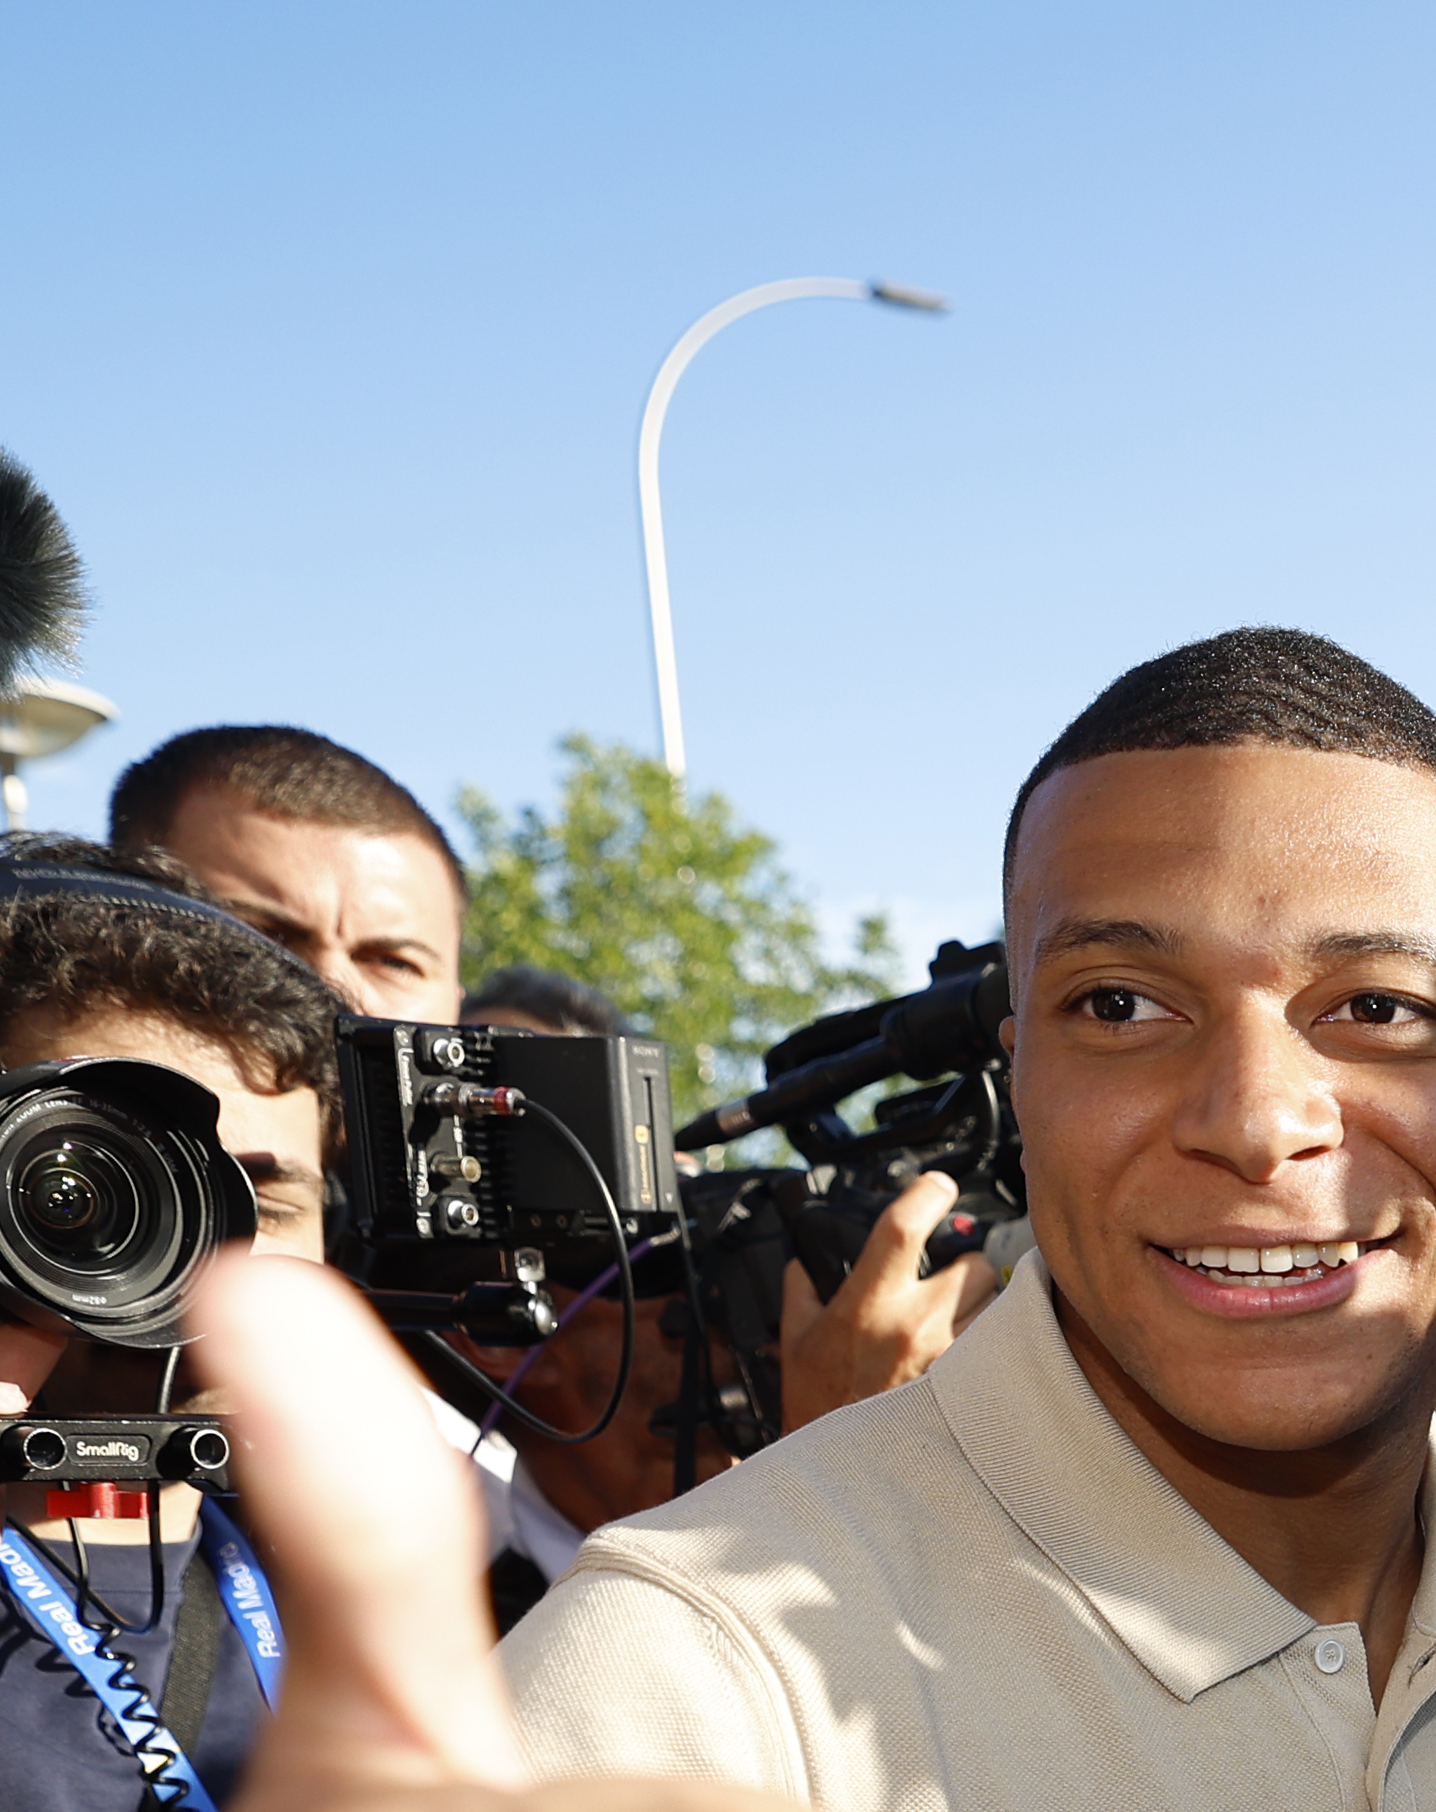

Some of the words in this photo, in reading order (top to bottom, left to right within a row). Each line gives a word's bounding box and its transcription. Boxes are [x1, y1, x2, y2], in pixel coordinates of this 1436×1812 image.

[76, 1441, 139, 1461] SmallRig
[39, 1601, 96, 1655] Real
[242, 1611, 281, 1658] Real
